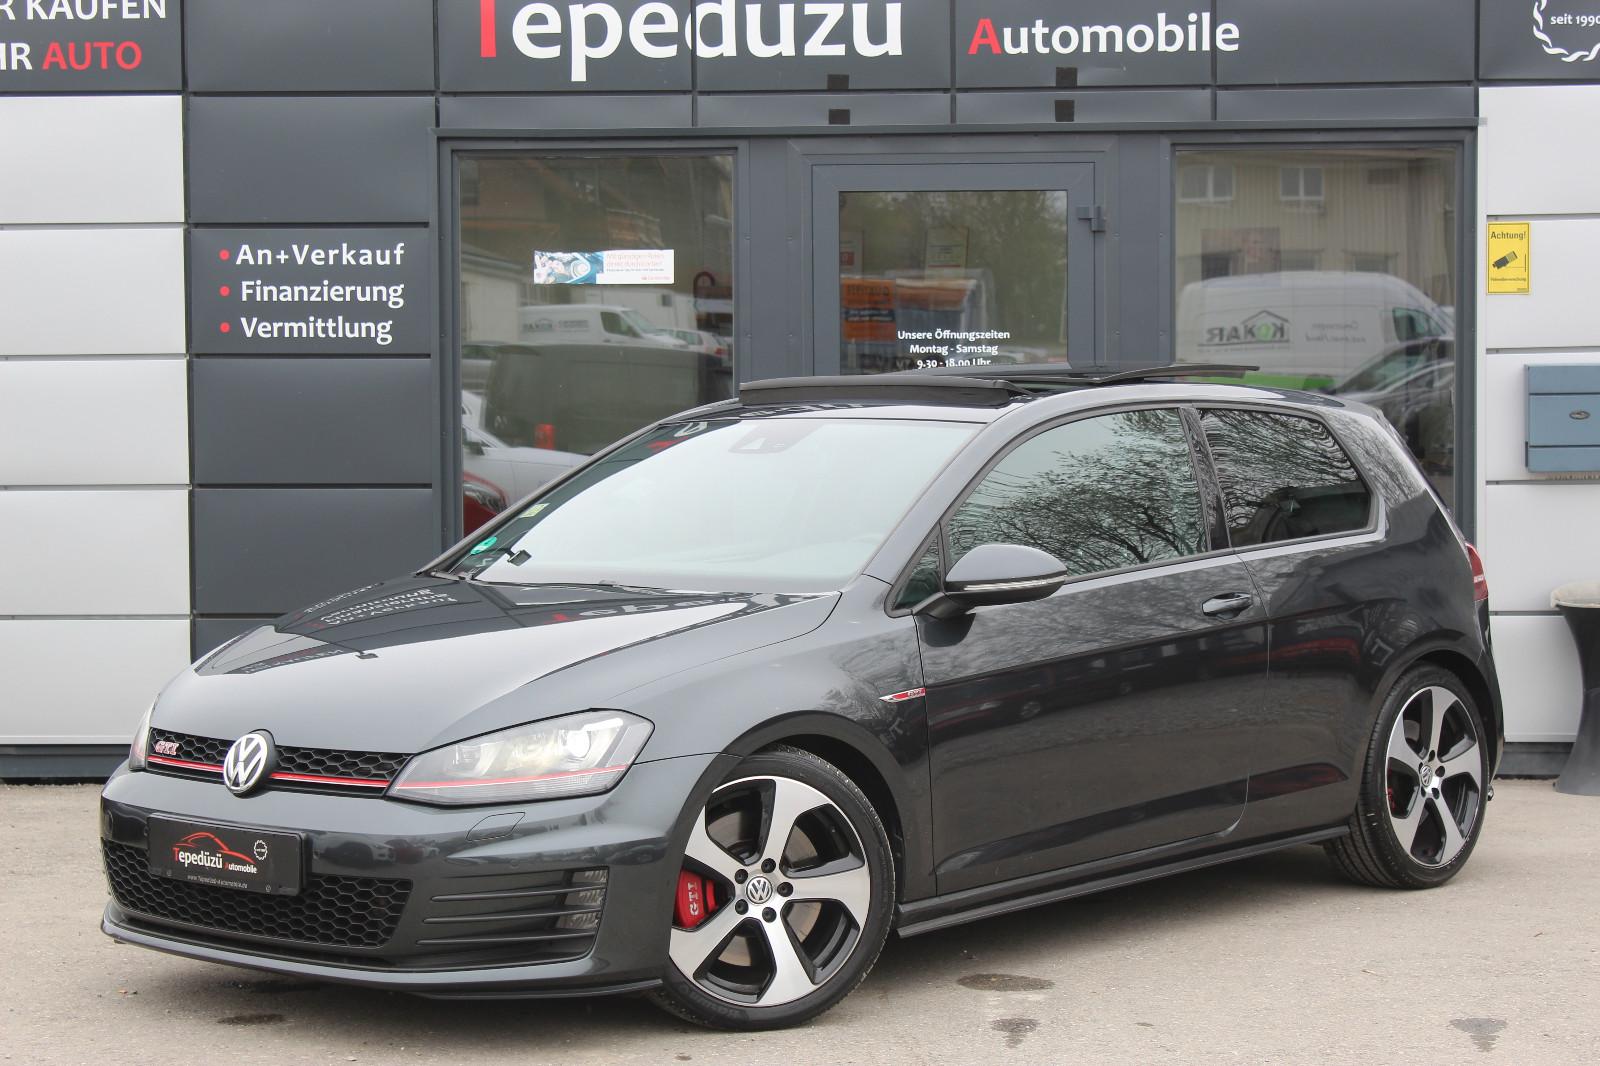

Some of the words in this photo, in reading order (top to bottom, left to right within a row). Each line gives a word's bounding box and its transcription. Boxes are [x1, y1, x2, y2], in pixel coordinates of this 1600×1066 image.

[26, 0, 166, 20] KAUFEN
[1550, 13, 1573, 25] seit
[968, 12, 1240, 55] Automobile
[0, 42, 33, 70] R
[42, 41, 143, 70] AUTO
[1490, 231, 1527, 241] Achtung!
[235, 243, 405, 266] An+Verkauf
[240, 281, 405, 309] Finanzierung
[240, 317, 393, 345] Vermittlung
[897, 330, 932, 339] Unsere
[934, 328, 1010, 341] Öffnungszeiten
[909, 344, 949, 356] Montag
[956, 344, 999, 356] Samstag
[916, 359, 938, 370] 9.30
[154, 740, 179, 756] GTI
[172, 847, 223, 869] Tepedüzü
[225, 861, 257, 874] Automobile
[687, 882, 699, 916] GTI
